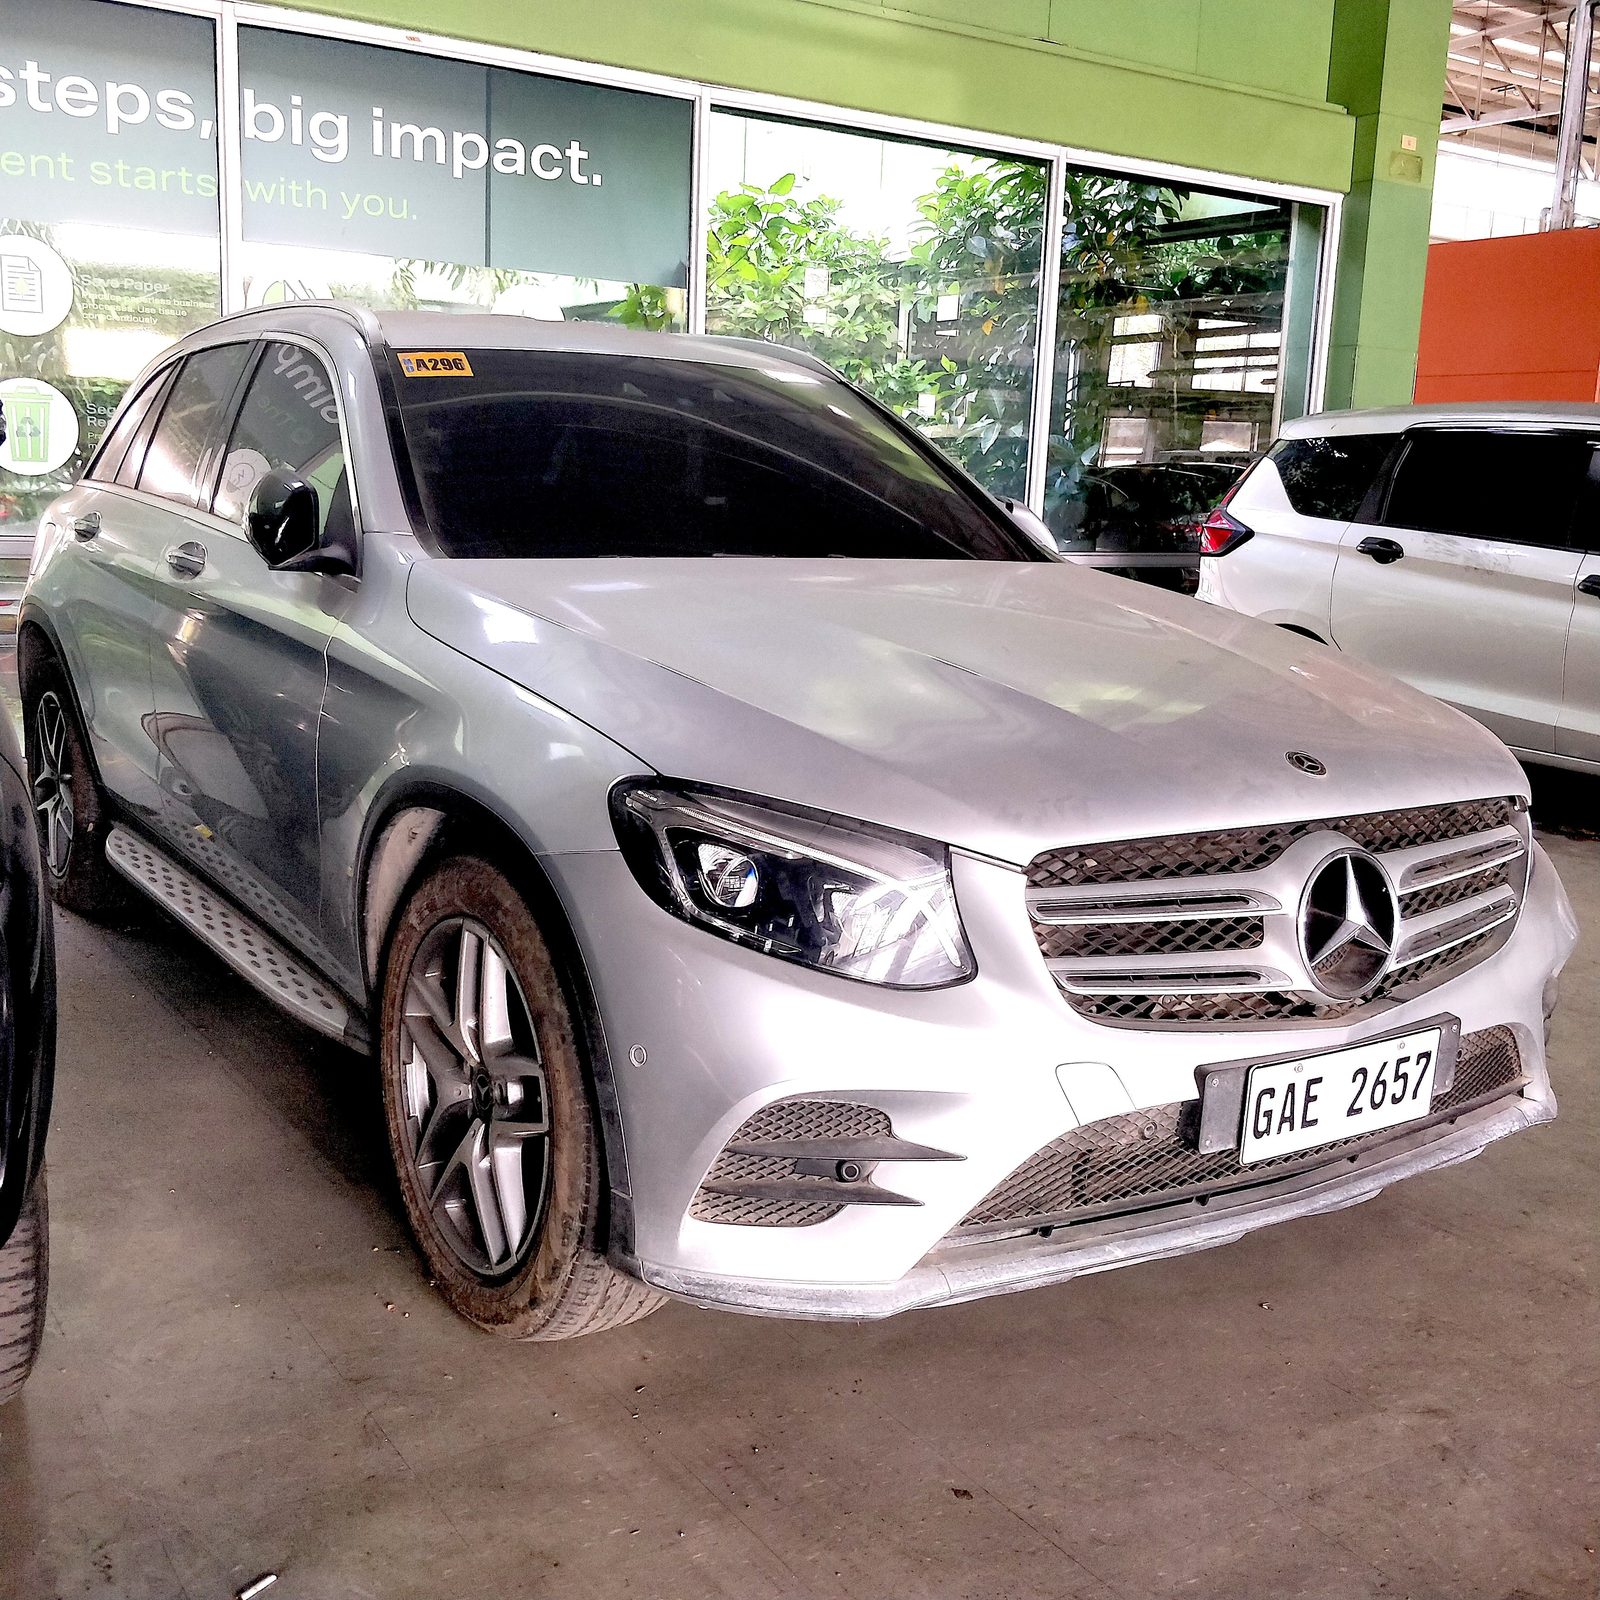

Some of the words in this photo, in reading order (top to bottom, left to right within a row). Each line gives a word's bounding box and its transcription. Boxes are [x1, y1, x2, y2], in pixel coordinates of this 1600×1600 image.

[243, 88, 349, 163] big
[372, 107, 602, 186] impact.
[90, 159, 217, 197] starts
[244, 176, 327, 210] with
[341, 191, 417, 220] you.
[80, 274, 120, 289] Save
[124, 278, 169, 293] Paper
[138, 306, 157, 315] Use
[159, 307, 187, 317] tissue
[415, 358, 465, 371] A296
[1252, 1077, 1324, 1139] GAE
[1346, 1051, 1432, 1118] 2657
